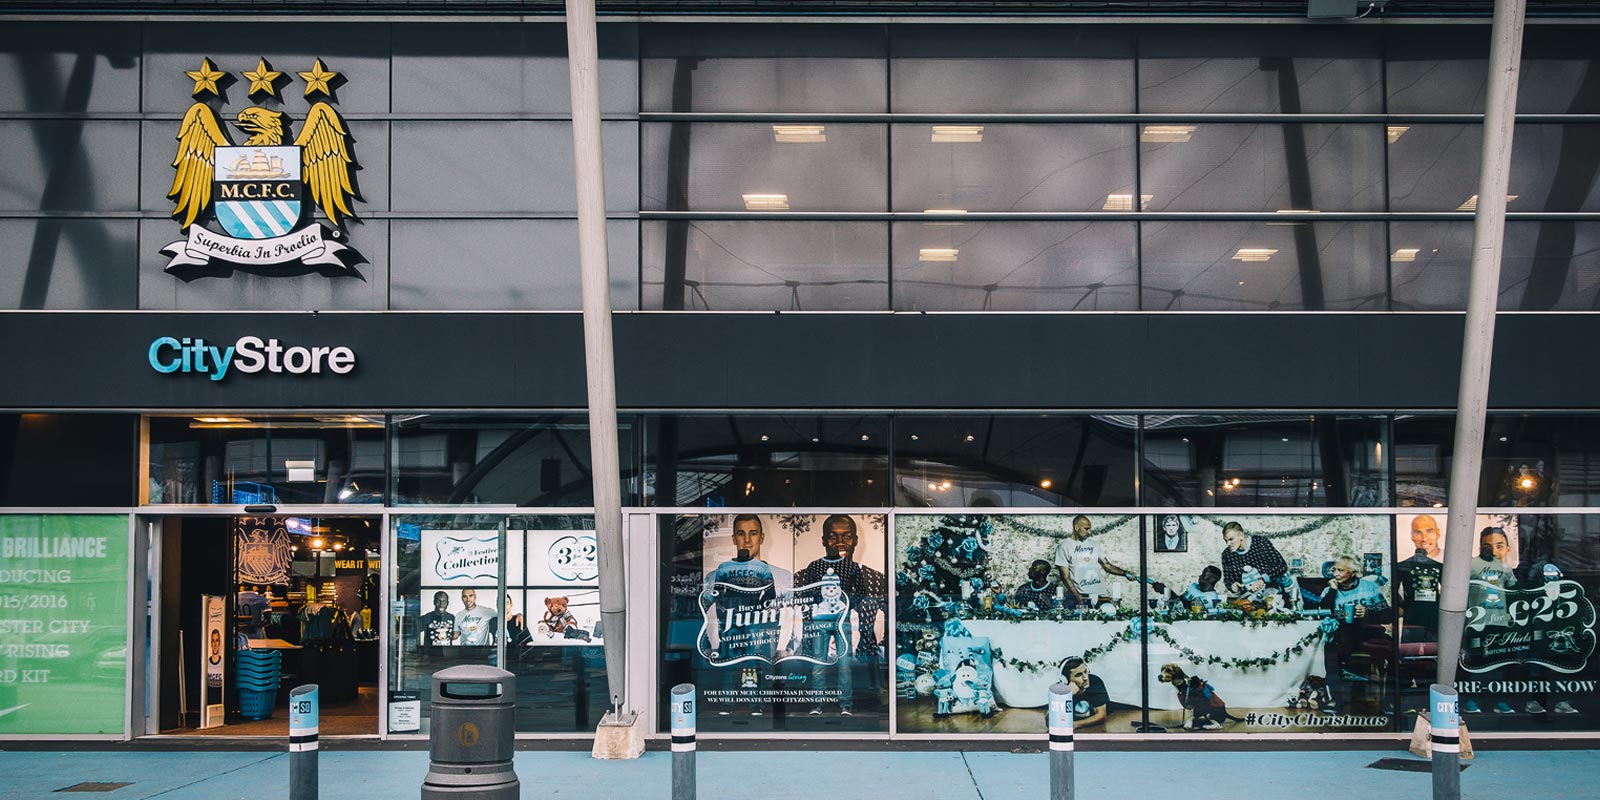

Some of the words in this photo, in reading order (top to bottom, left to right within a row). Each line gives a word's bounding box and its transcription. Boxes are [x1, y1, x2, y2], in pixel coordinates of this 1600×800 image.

[221, 183, 295, 198] M.C.F.C.
[194, 232, 251, 259] Superbia
[254, 246, 272, 259] In
[274, 234, 318, 257] Proelio
[148, 336, 355, 381] CityStore
[2, 537, 107, 558] BRILLIANCE
[558, 547, 572, 565] 3
[583, 545, 596, 562] 2
[335, 560, 355, 568] WEAR
[356, 560, 364, 568] IT
[0, 570, 71, 583] DUCING
[0, 594, 68, 611] 15/2016
[738, 604, 755, 612] Buy
[763, 596, 814, 608] Christmas
[1465, 606, 1486, 632] 2
[1489, 612, 1504, 625] for
[1508, 588, 1578, 627] £25
[0, 620, 43, 633] STER
[49, 620, 90, 633] CITY
[749, 630, 777, 639] YOUNG
[749, 638, 780, 647] THROUG
[8, 644, 70, 658] RISING
[22, 669, 50, 682] KIT
[1556, 681, 1597, 693] NOW
[1437, 702, 1455, 713] CITY
[1245, 713, 1388, 729] #CityChristmas
